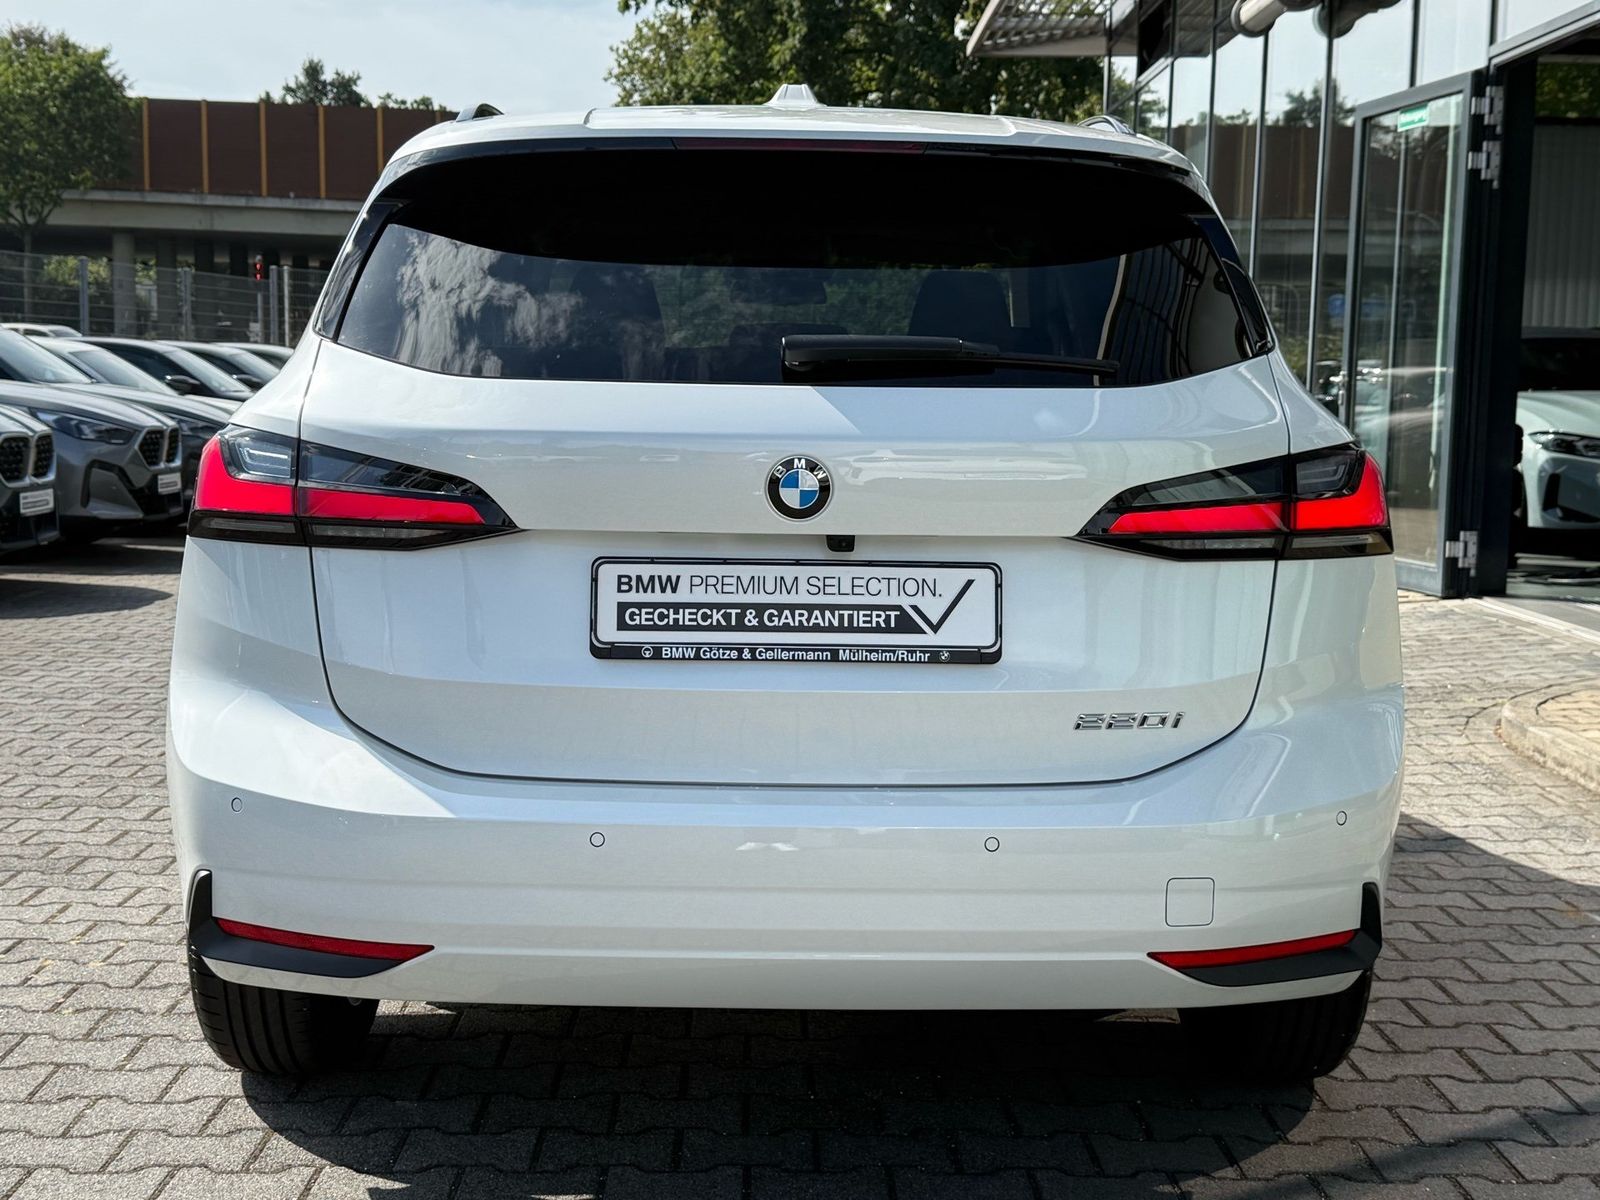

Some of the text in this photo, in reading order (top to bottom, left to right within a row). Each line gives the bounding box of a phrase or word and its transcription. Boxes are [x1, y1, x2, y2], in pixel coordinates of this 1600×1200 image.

[773, 458, 827, 480] BMW
[616, 574, 943, 598] BMW PREMIUM SELECTION.
[624, 607, 900, 628] GECHECKT & GARANTIERT
[661, 647, 931, 662] BMW Götze & Gellermann Mülheim/Ruhr
[1073, 711, 1185, 730] 220i
